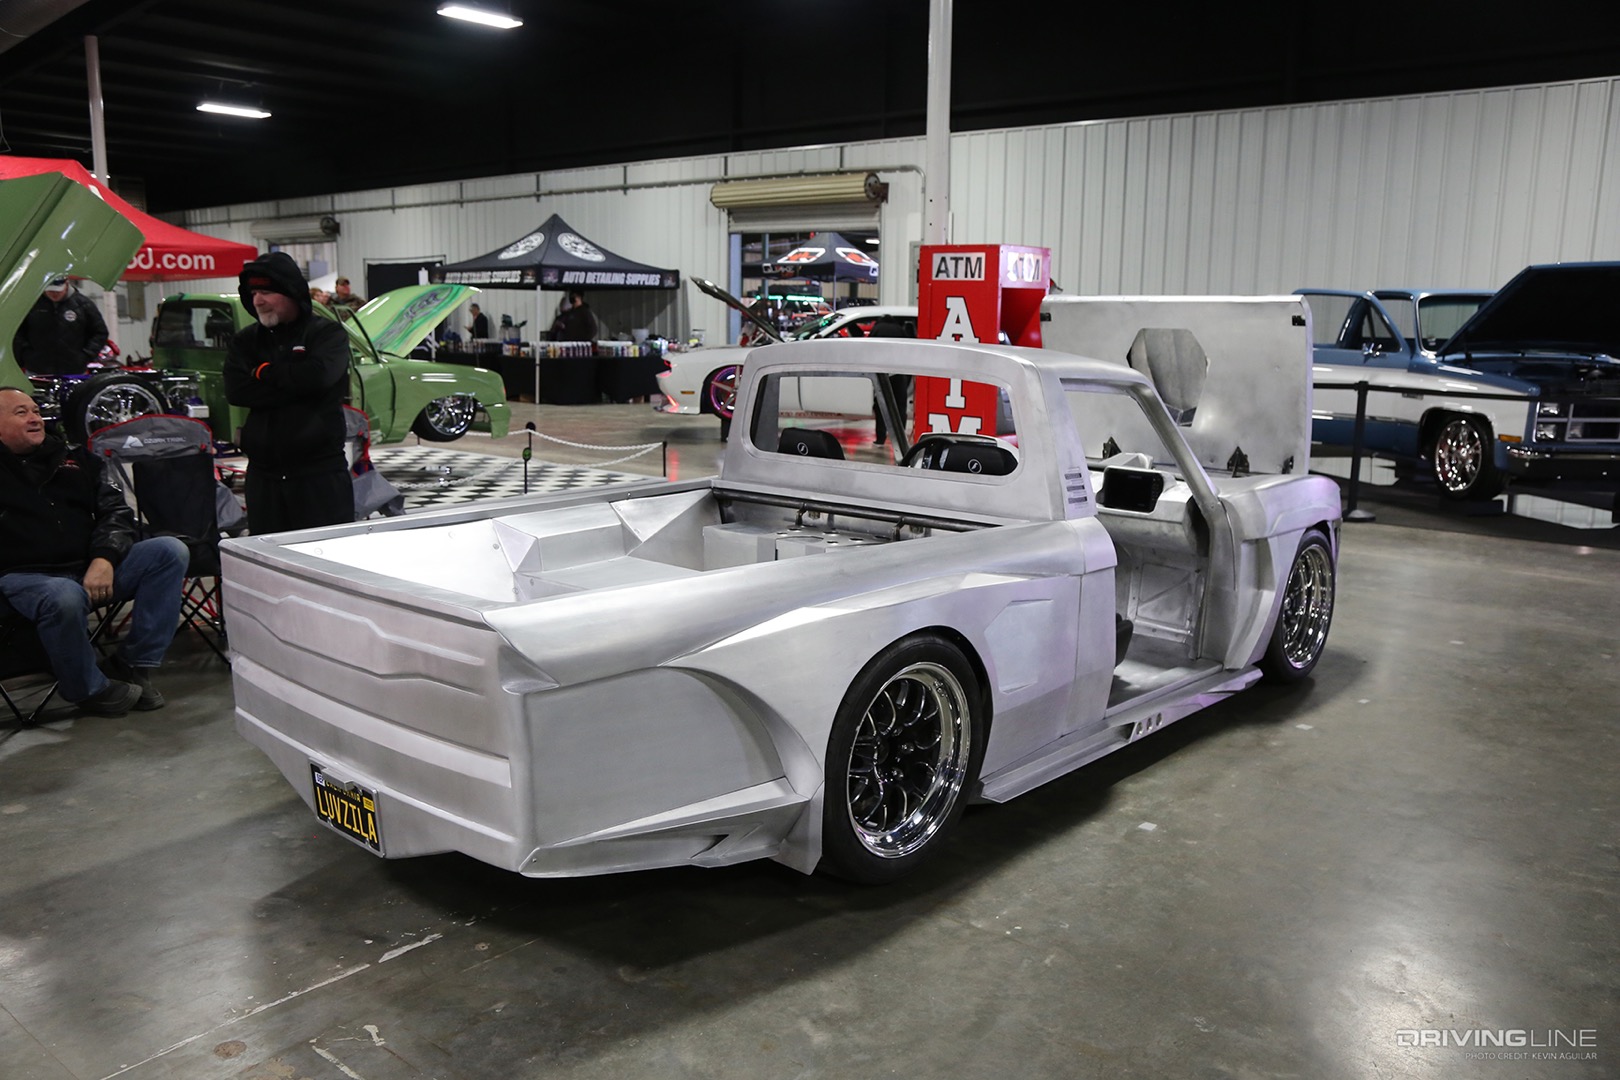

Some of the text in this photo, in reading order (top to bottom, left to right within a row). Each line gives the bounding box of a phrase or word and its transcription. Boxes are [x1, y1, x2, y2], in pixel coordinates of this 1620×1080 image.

[562, 271, 586, 284] AUTO
[585, 272, 625, 285] DETAILING
[625, 273, 661, 286] SUPPLIES
[935, 256, 982, 279] ATM
[316, 786, 378, 844] LUVZILA
